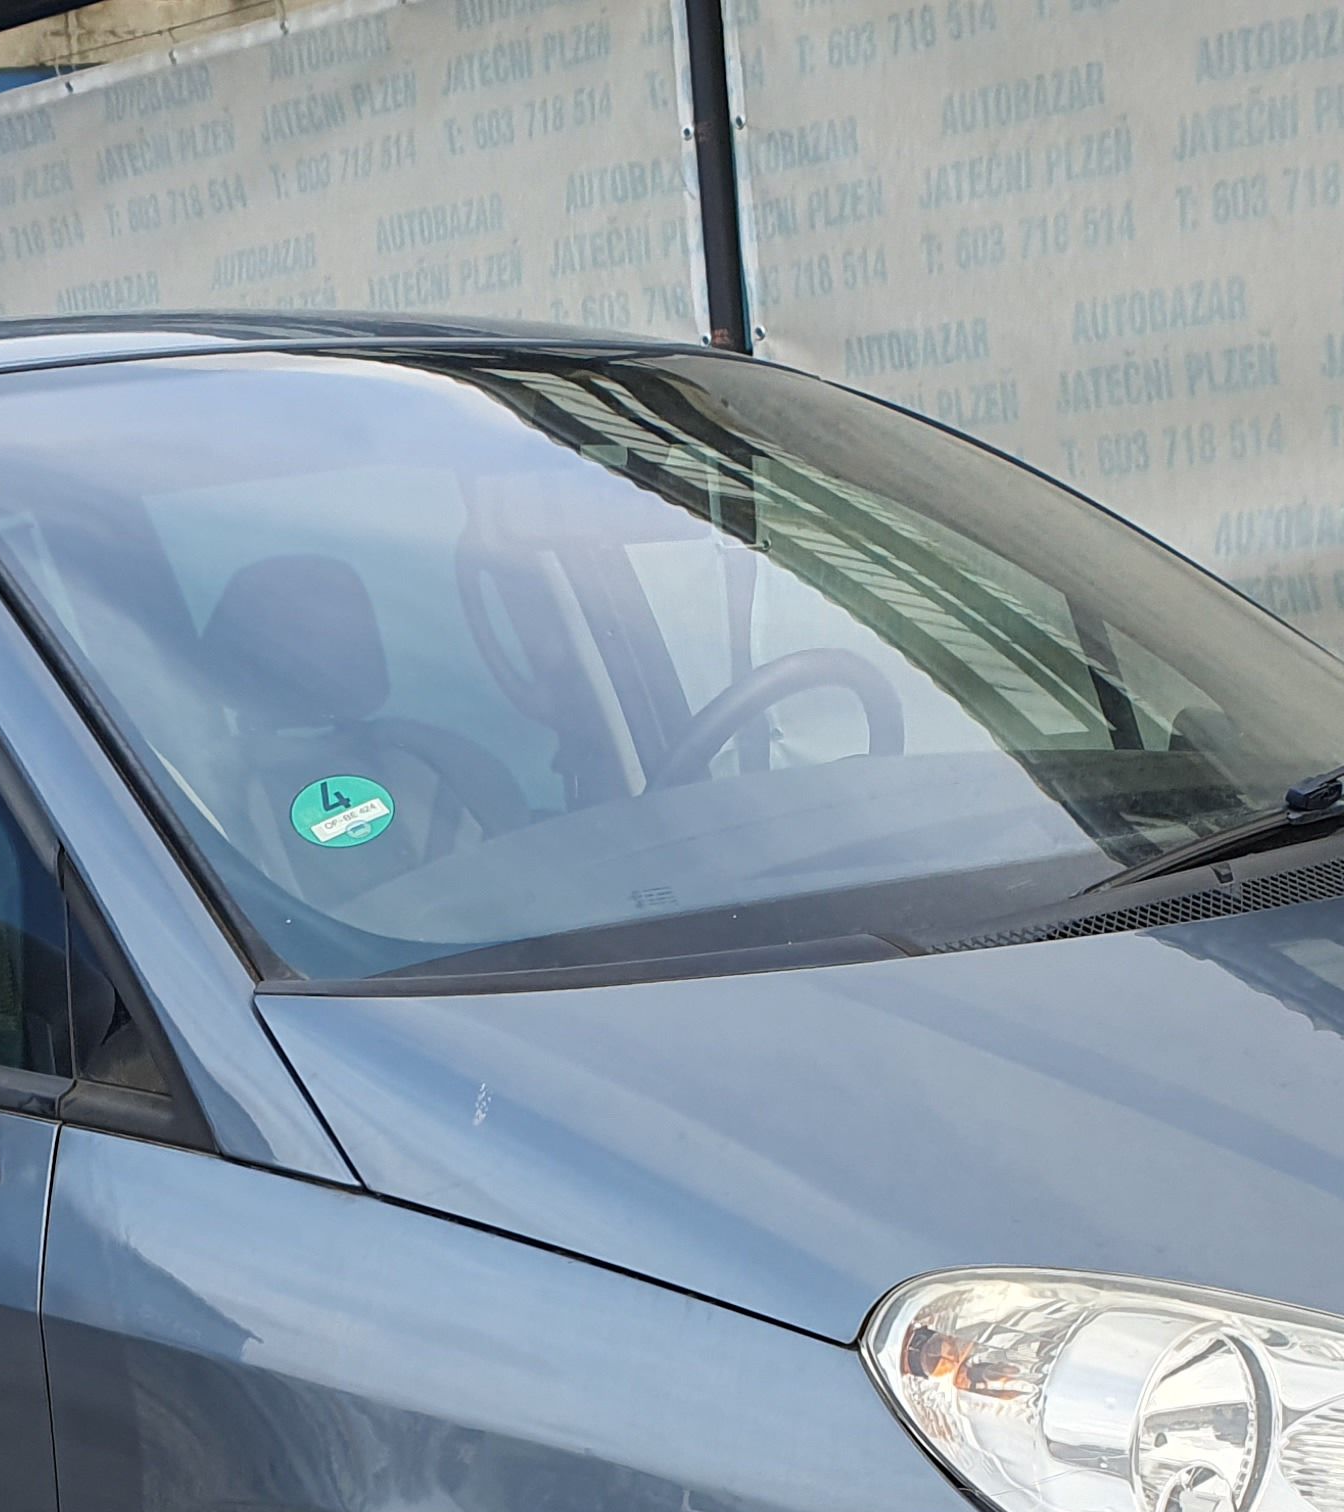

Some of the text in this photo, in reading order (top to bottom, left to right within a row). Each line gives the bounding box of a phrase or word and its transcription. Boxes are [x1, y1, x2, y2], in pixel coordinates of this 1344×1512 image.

[267, 14, 392, 83] AUTOBAZAR
[441, 32, 533, 97] JATEČNÍ
[543, 7, 611, 74] PLZEŇ
[829, 21, 876, 70] 603
[888, 6, 935, 54] 718
[946, 0, 997, 41] 514
[260, 59, 417, 145] JATEČNÍ PLZEŇ
[444, 82, 612, 155] T: 603 718 514
[941, 61, 1105, 136] AUTOBAZAR
[1173, 84, 1299, 162] JATEČNÍ
[95, 105, 235, 187] JATEČNÍ PLZEŇ
[269, 128, 416, 198] T: 603 718 514
[918, 112, 1133, 210] JATEČNÍ PLZEŇ
[168, 185, 204, 225] 718
[208, 173, 248, 214] 514
[376, 191, 504, 256] AUTOBAZAR
[808, 166, 887, 230] PLZEŇ
[1176, 185, 1198, 232] T:
[1212, 172, 1269, 225] 603
[1283, 160, 1341, 214] 718
[10, 220, 46, 260] 718
[50, 209, 85, 251] 514
[210, 233, 317, 292] AUTOBAZAR
[460, 238, 523, 295] PLZEŇ
[550, 217, 651, 279] JATEČNÍ
[921, 199, 1135, 274] T: 603 718 514
[791, 242, 887, 300] 718 514
[1072, 273, 1248, 345] AUTOBAZAR
[844, 316, 990, 374] AUTOBAZAR
[1056, 327, 1281, 414] JATEČNÍ PLZEŇ
[1098, 430, 1150, 476] 603
[1162, 422, 1216, 470] 718
[1229, 411, 1284, 459] 514
[320, 781, 351, 812] 4
